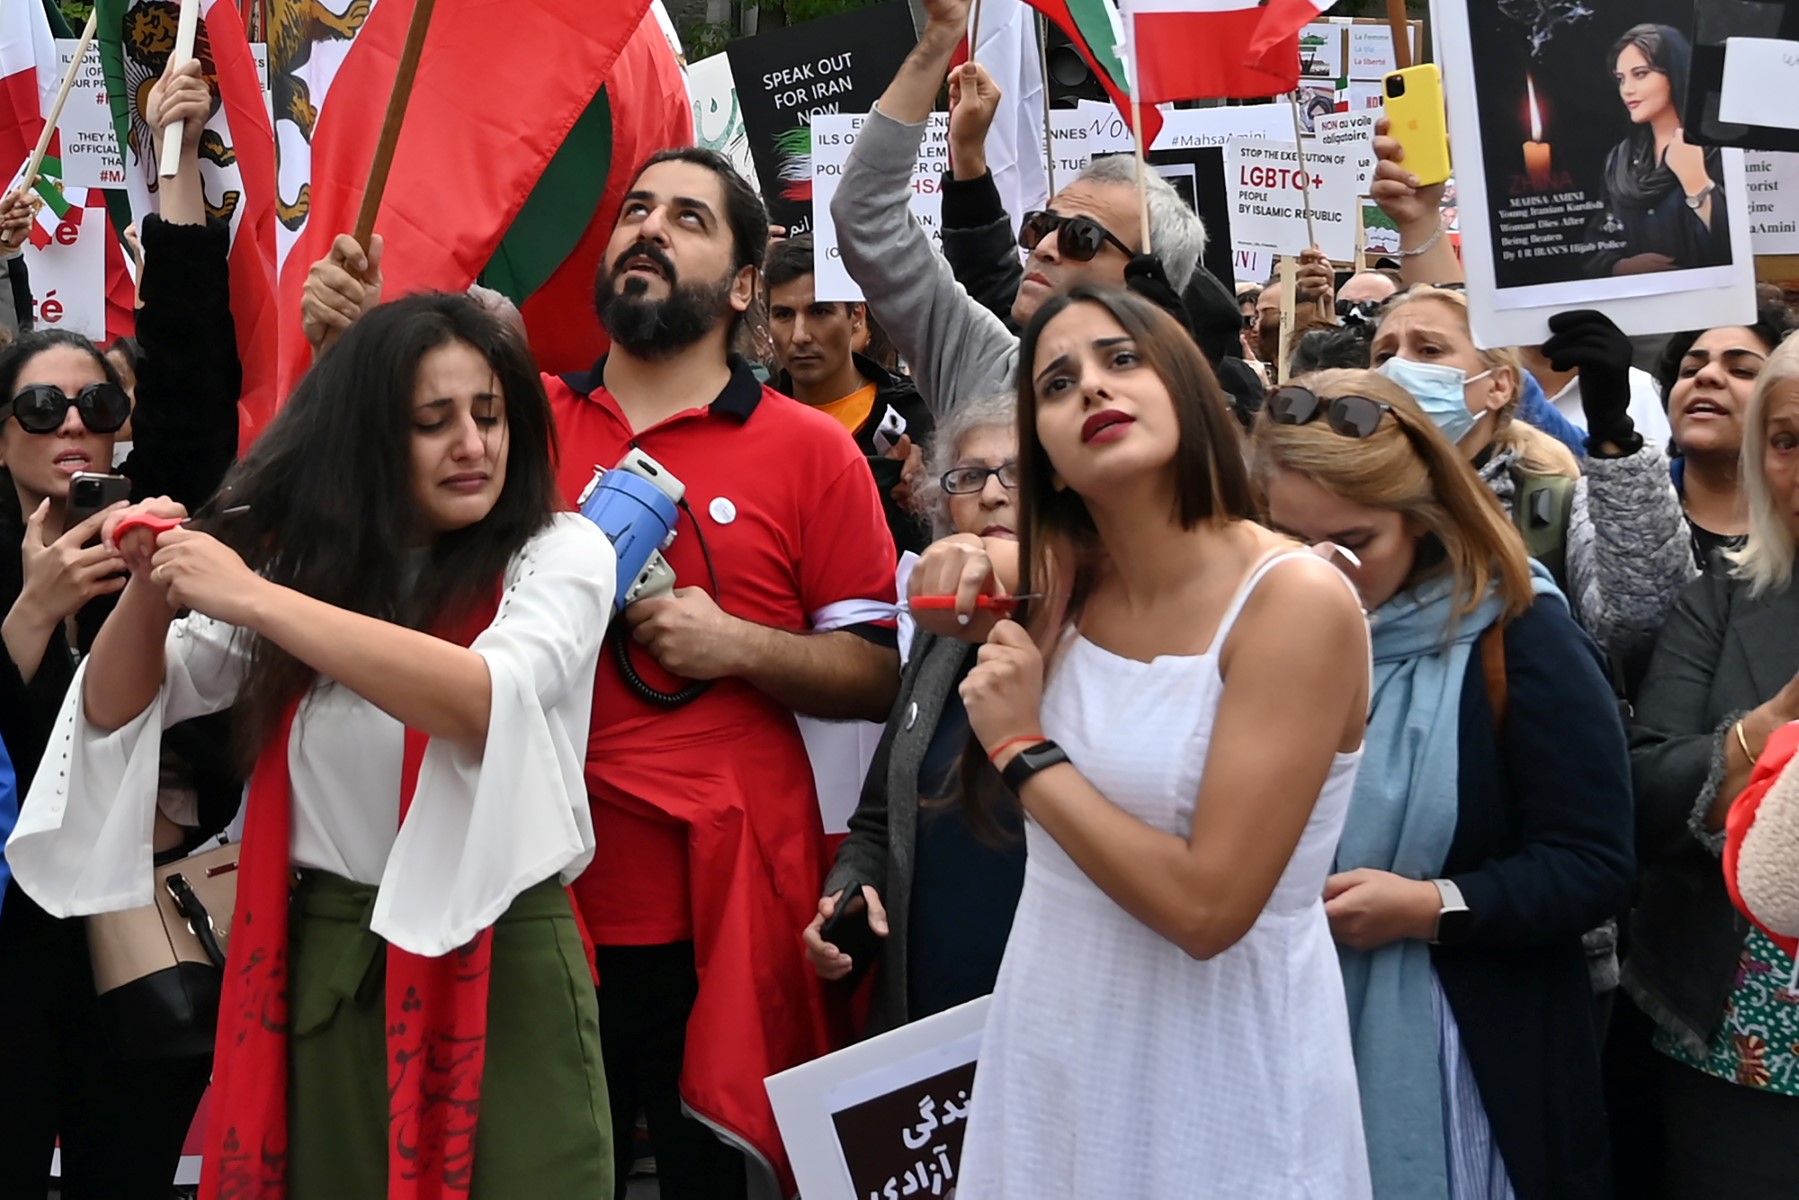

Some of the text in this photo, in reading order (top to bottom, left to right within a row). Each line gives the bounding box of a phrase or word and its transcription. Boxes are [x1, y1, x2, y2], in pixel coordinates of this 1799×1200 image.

[762, 52, 852, 90] SPEAK OUT
[774, 75, 853, 110] FOR IRAN
[1321, 120, 1338, 131] NON
[1350, 115, 1372, 127] voile
[77, 132, 105, 142] THEY
[818, 134, 840, 145] ILS
[1240, 147, 1263, 158] STOP
[1264, 150, 1280, 160] THE
[1333, 155, 1346, 165] OF
[1238, 190, 1268, 202] PEOPLE
[1509, 191, 1585, 208] MAHSA AMINI
[1238, 203, 1342, 222] BY ISLAMIC REPUBLIC
[1498, 200, 1605, 219] Young Iranian Kurdish
[1499, 216, 1586, 233] Woman Dies After
[1501, 236, 1530, 247] Being
[1502, 250, 1517, 262] By
[1597, 240, 1628, 251] Police
